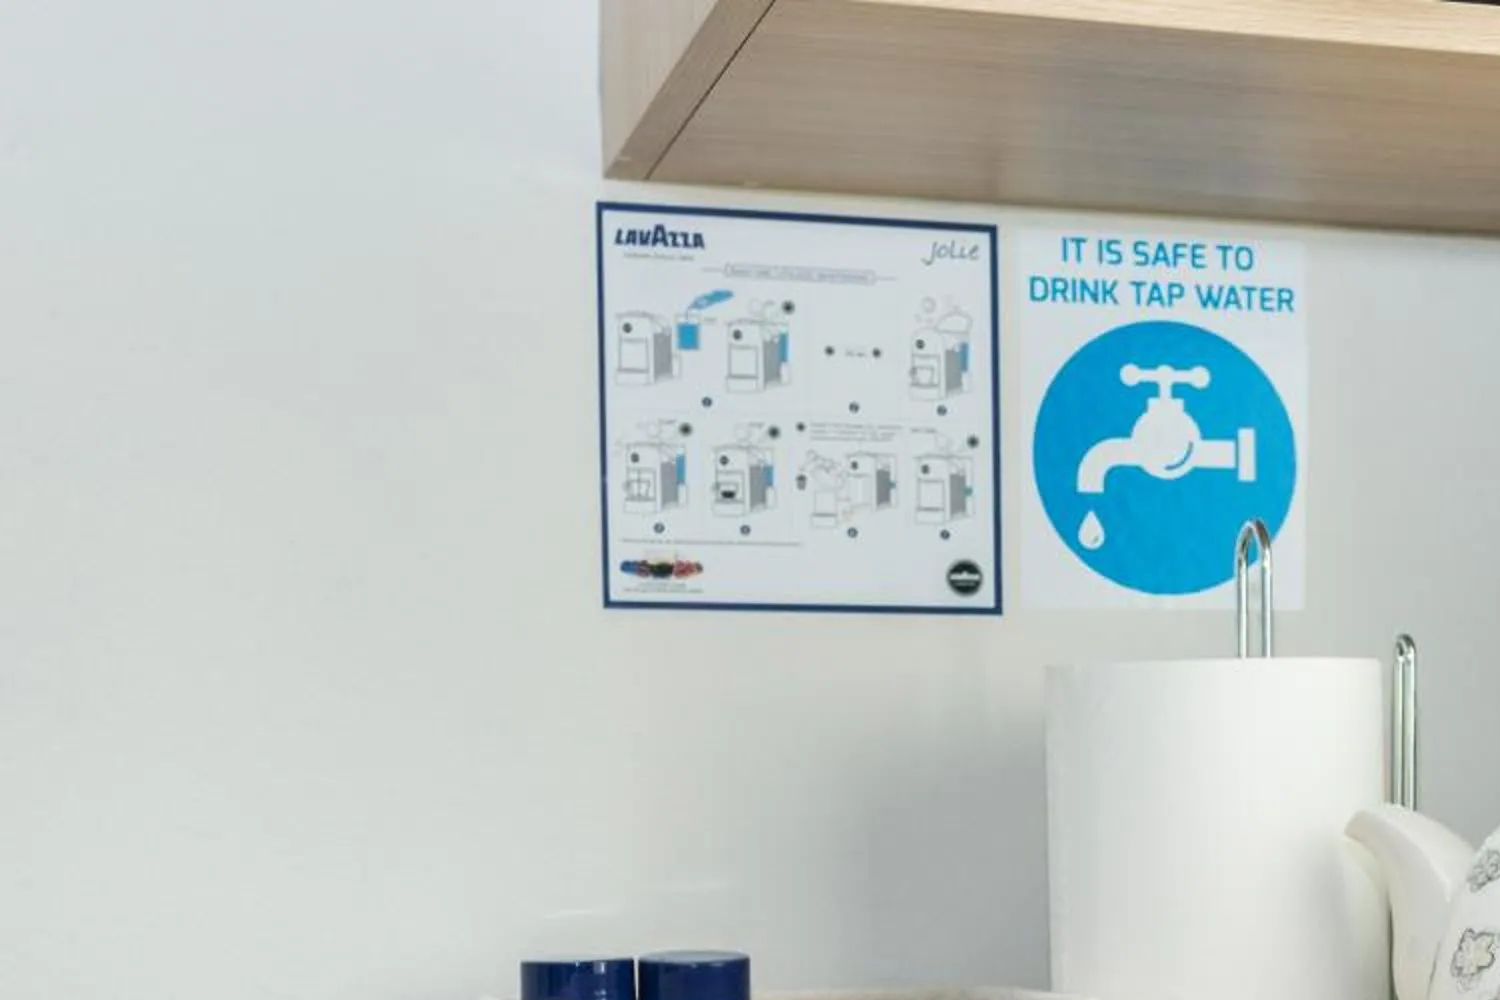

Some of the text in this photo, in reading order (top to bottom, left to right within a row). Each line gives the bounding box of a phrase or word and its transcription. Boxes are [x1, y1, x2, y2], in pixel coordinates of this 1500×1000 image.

[614, 223, 705, 250] LAVAZZA
[1061, 236, 1255, 272] IT IS SAFE TO
[1028, 275, 1295, 313] DRINK TAP WATER
